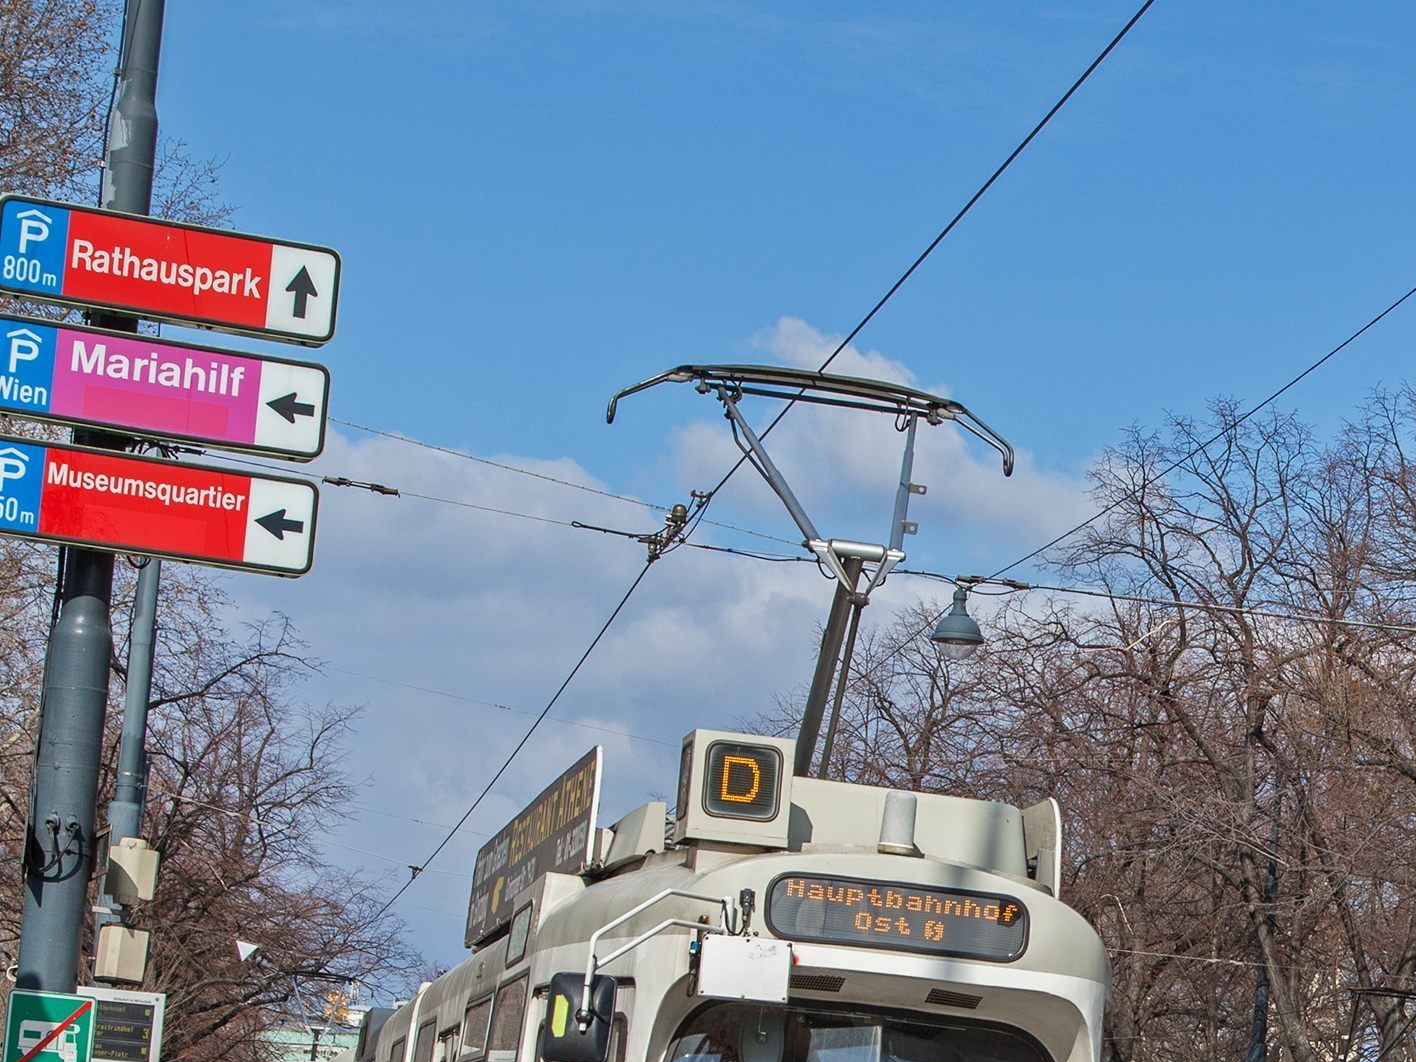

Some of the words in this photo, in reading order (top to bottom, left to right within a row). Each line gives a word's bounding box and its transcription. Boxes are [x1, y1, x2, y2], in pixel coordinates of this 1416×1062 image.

[70, 238, 262, 299] Rathauspark
[70, 340, 246, 398] Mariahilf
[47, 461, 246, 512] Museumsquartier
[721, 755, 760, 803] D
[786, 879, 1018, 922] Hauptbahnhof
[854, 911, 911, 935] Ost
[142, 1028, 149, 1040] 3
